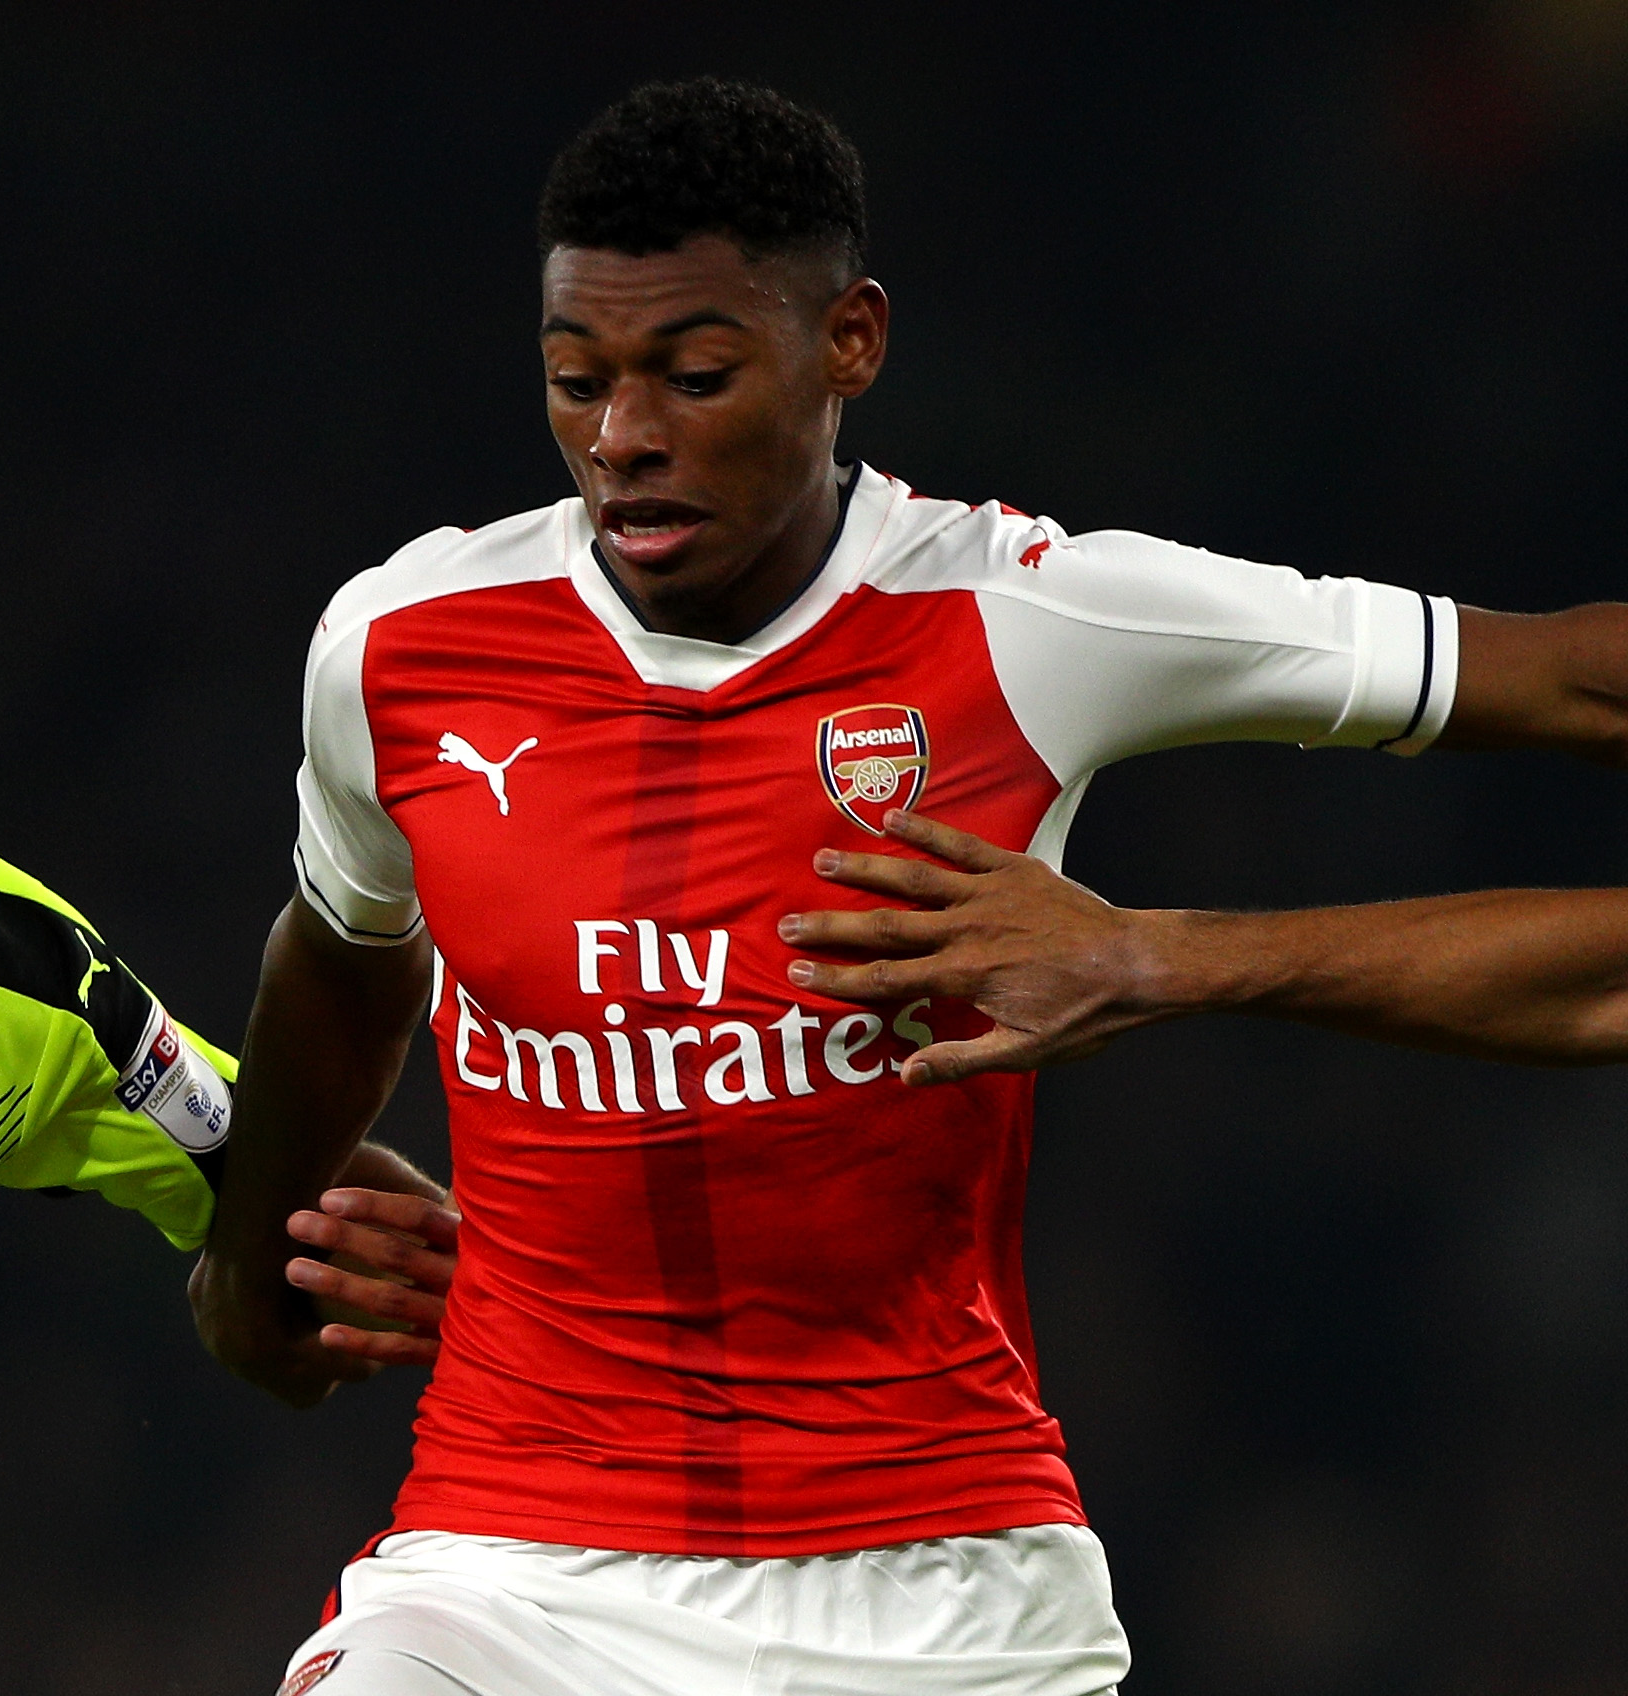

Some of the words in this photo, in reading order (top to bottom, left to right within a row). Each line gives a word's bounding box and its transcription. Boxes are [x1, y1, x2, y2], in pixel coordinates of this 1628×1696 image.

[831, 721, 913, 750] Arsenal
[572, 919, 730, 1008] Fly
[124, 1058, 158, 1105] sky
[157, 1015, 178, 1058] BE
[455, 982, 934, 1115] Emirates
[206, 1104, 226, 1134] EFL
